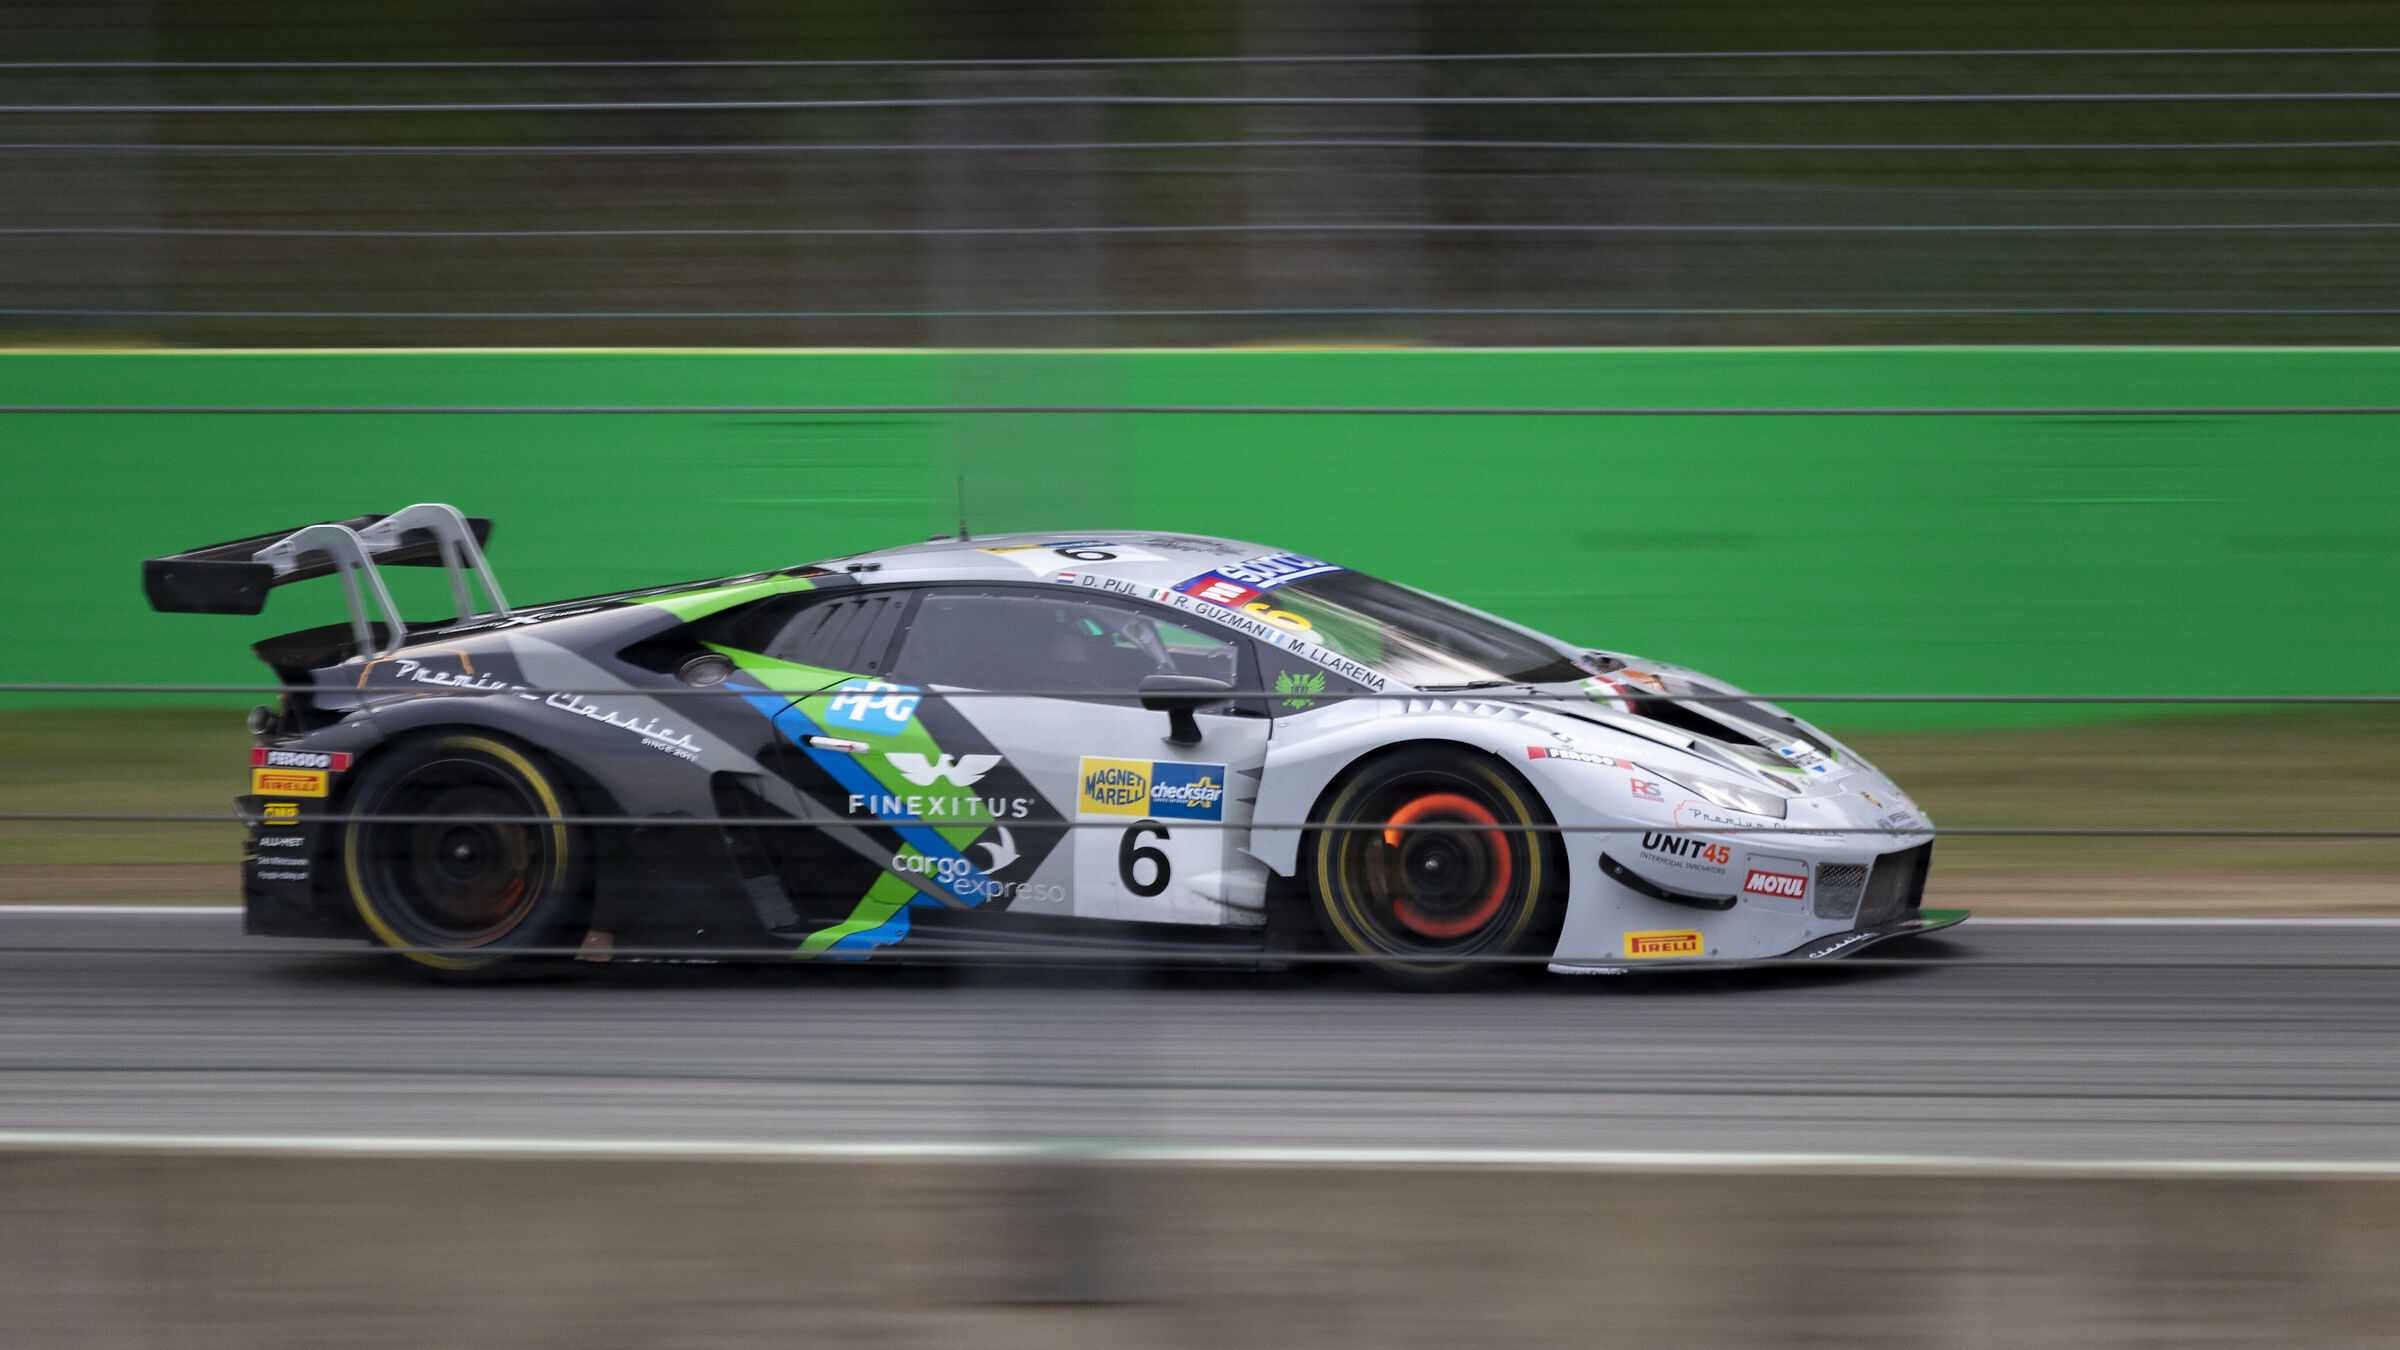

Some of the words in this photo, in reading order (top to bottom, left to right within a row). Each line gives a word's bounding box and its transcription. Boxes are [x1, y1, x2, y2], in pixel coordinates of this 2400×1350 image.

[1082, 575, 1098, 588] D.
[1103, 578, 1138, 596] PIJL
[1174, 596, 1189, 610] R.
[1195, 602, 1266, 636] GUZMAN
[1244, 602, 1312, 632] 6
[1288, 639, 1304, 656] M.
[1310, 648, 1385, 692] LLARENA
[830, 681, 920, 722] PPG
[267, 750, 332, 769] FERODO
[1549, 748, 1615, 767] FERODO
[260, 774, 318, 792] PIRELLI
[1151, 781, 1222, 803] checkstar
[1630, 778, 1661, 797] RS
[848, 794, 1030, 819] FINEXITUS
[1118, 819, 1171, 898] 6
[1642, 831, 1731, 865] UNIT45
[891, 853, 971, 884] cargo
[1640, 852, 1683, 868] INTERMODAL
[1685, 862, 1726, 876] INNOVATORS
[953, 877, 1065, 903] expreso
[1746, 872, 1804, 897] MOTUL
[1631, 935, 1697, 954] PIRELLI
